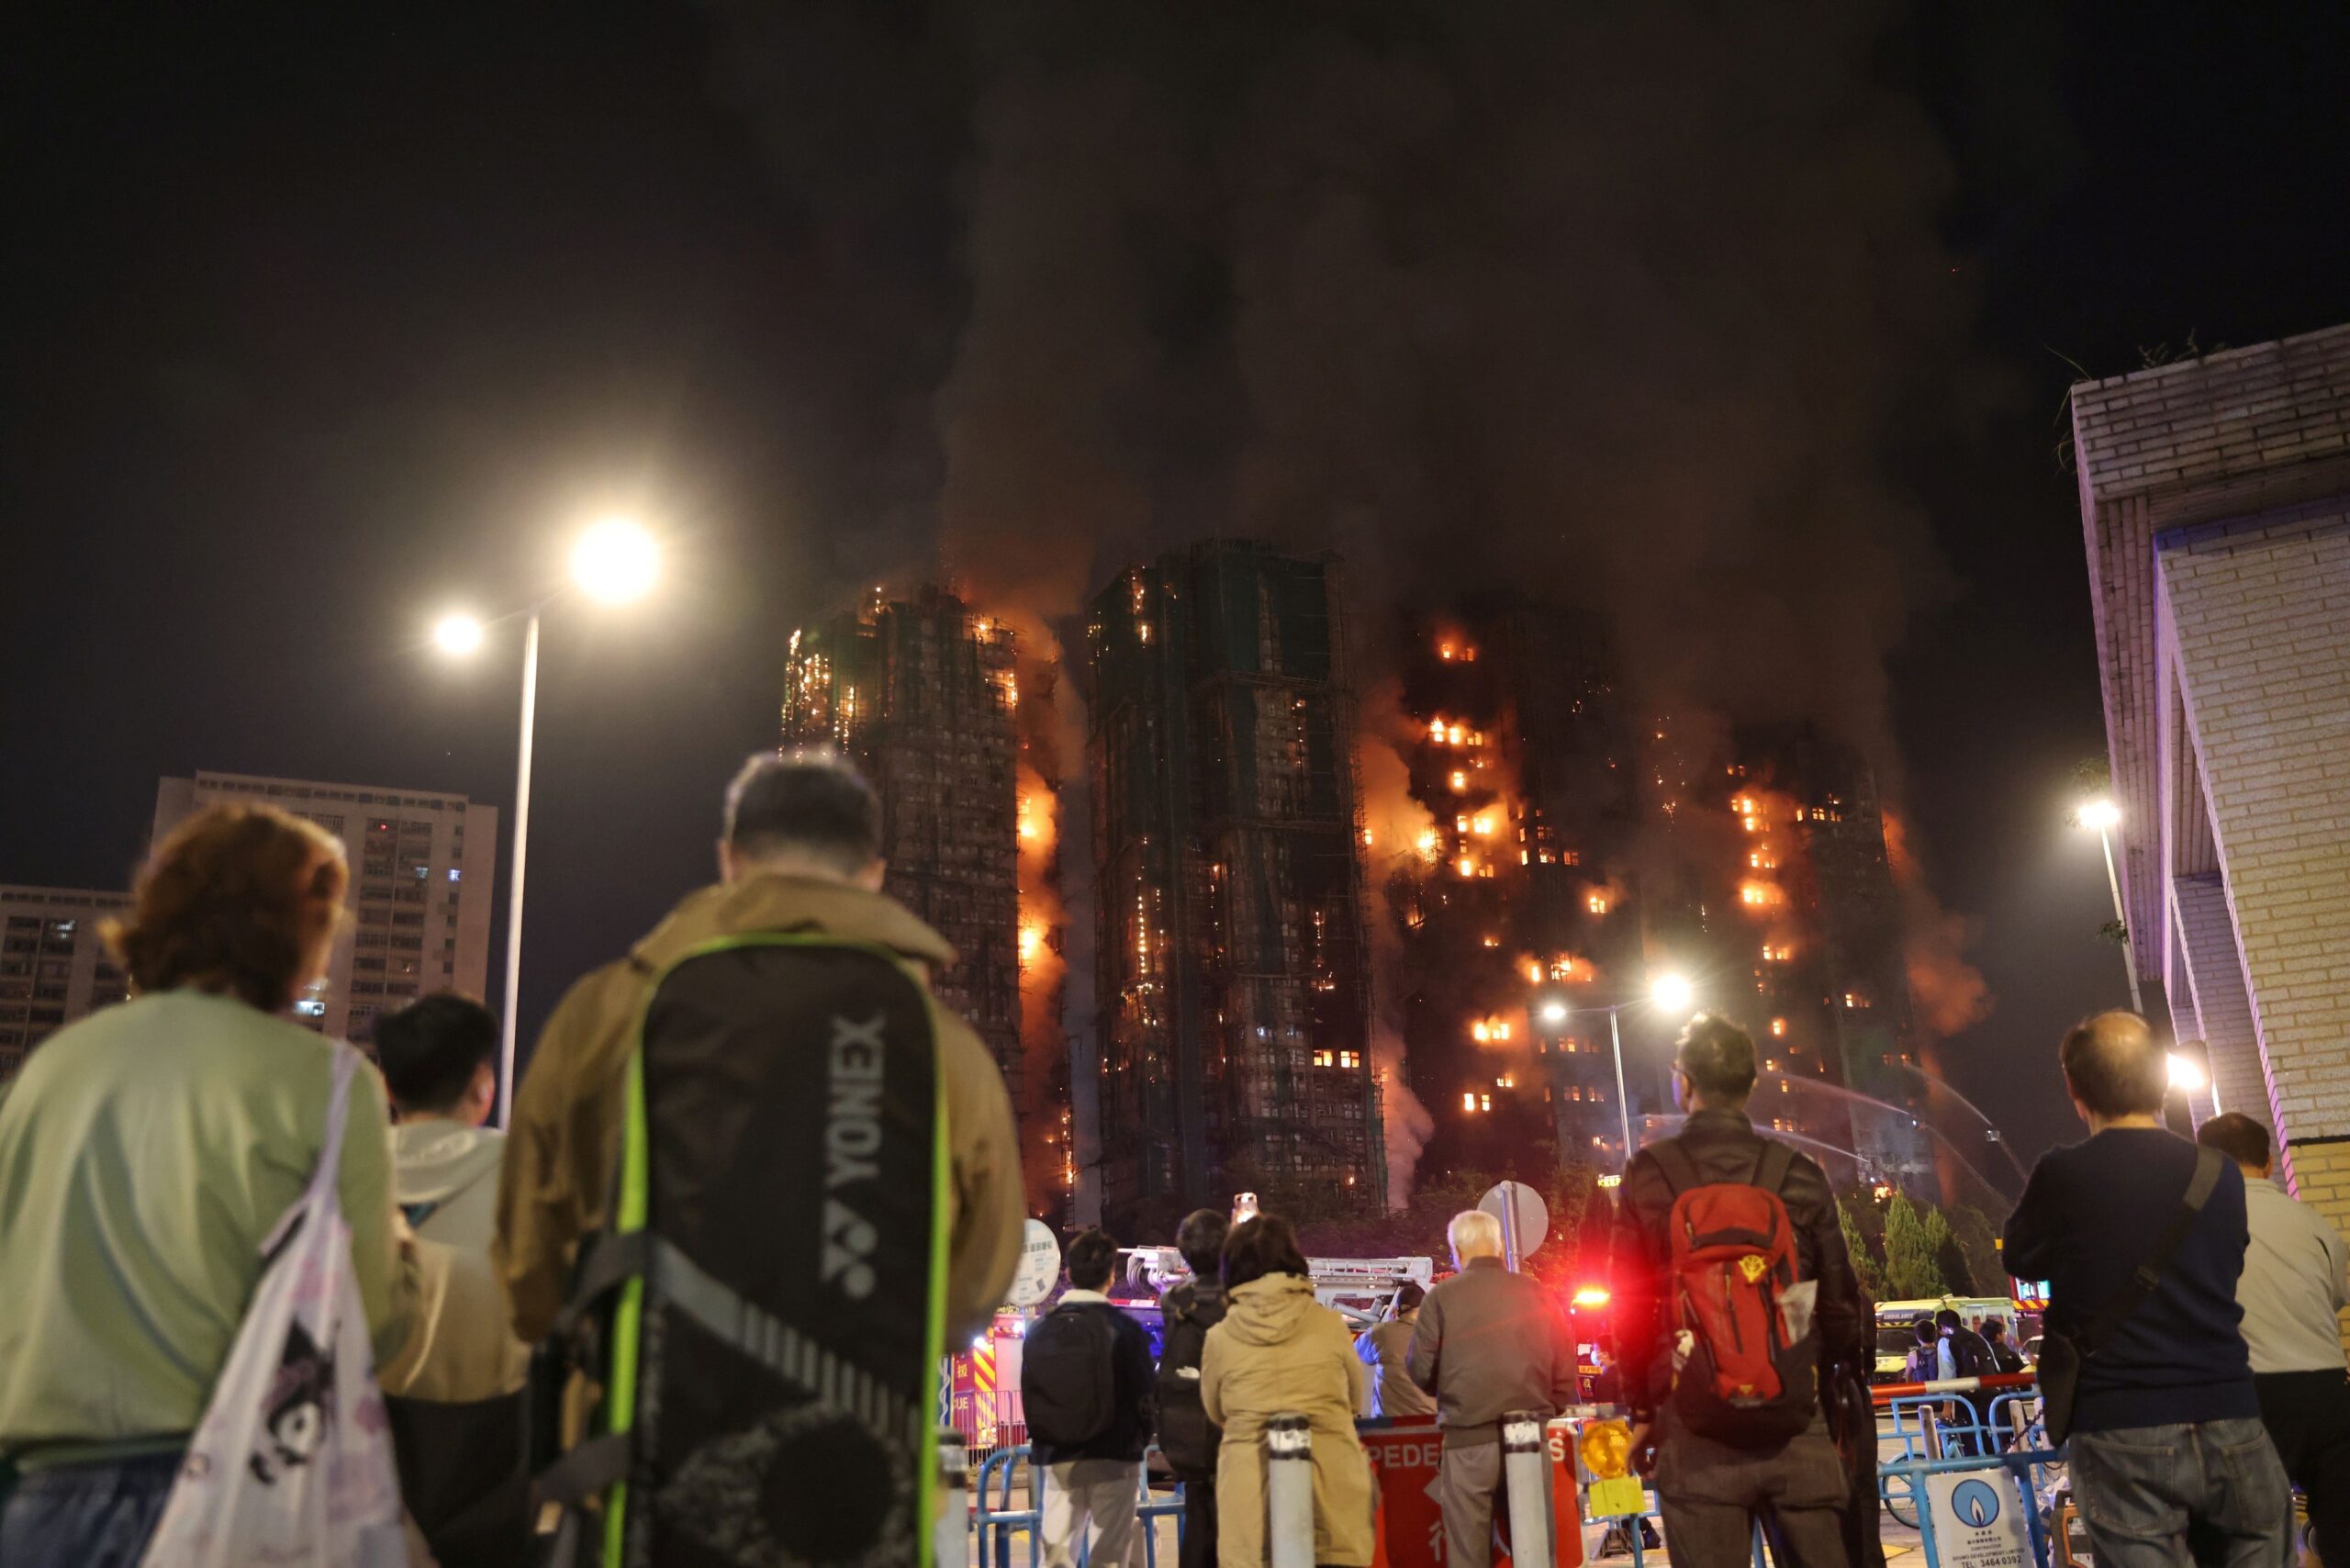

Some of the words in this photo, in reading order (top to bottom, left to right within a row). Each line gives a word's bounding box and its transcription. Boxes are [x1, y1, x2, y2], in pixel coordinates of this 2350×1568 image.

[824, 1014, 886, 1186] YONEX
[1980, 1557, 2000, 1567] 3464
[2001, 1555, 2022, 1565] 0392
